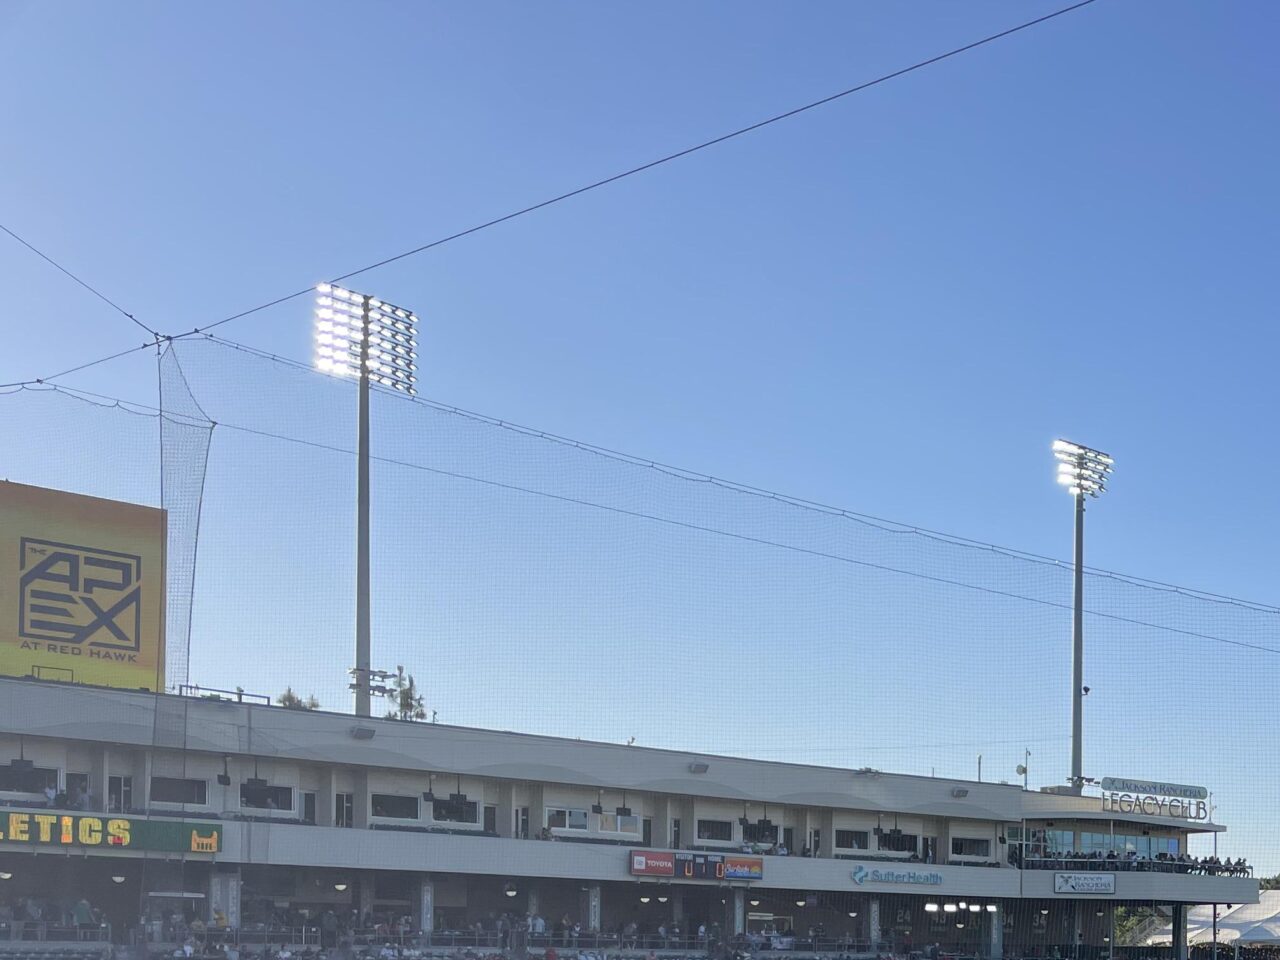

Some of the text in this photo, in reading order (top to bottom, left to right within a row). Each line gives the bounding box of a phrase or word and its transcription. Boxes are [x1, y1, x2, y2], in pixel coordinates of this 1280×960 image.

[20, 640, 137, 662] AT RED HAWK
[1102, 791, 1207, 820] LEGACY CLUB
[0, 812, 131, 846] ETICS
[647, 860, 672, 868] TOYOTA
